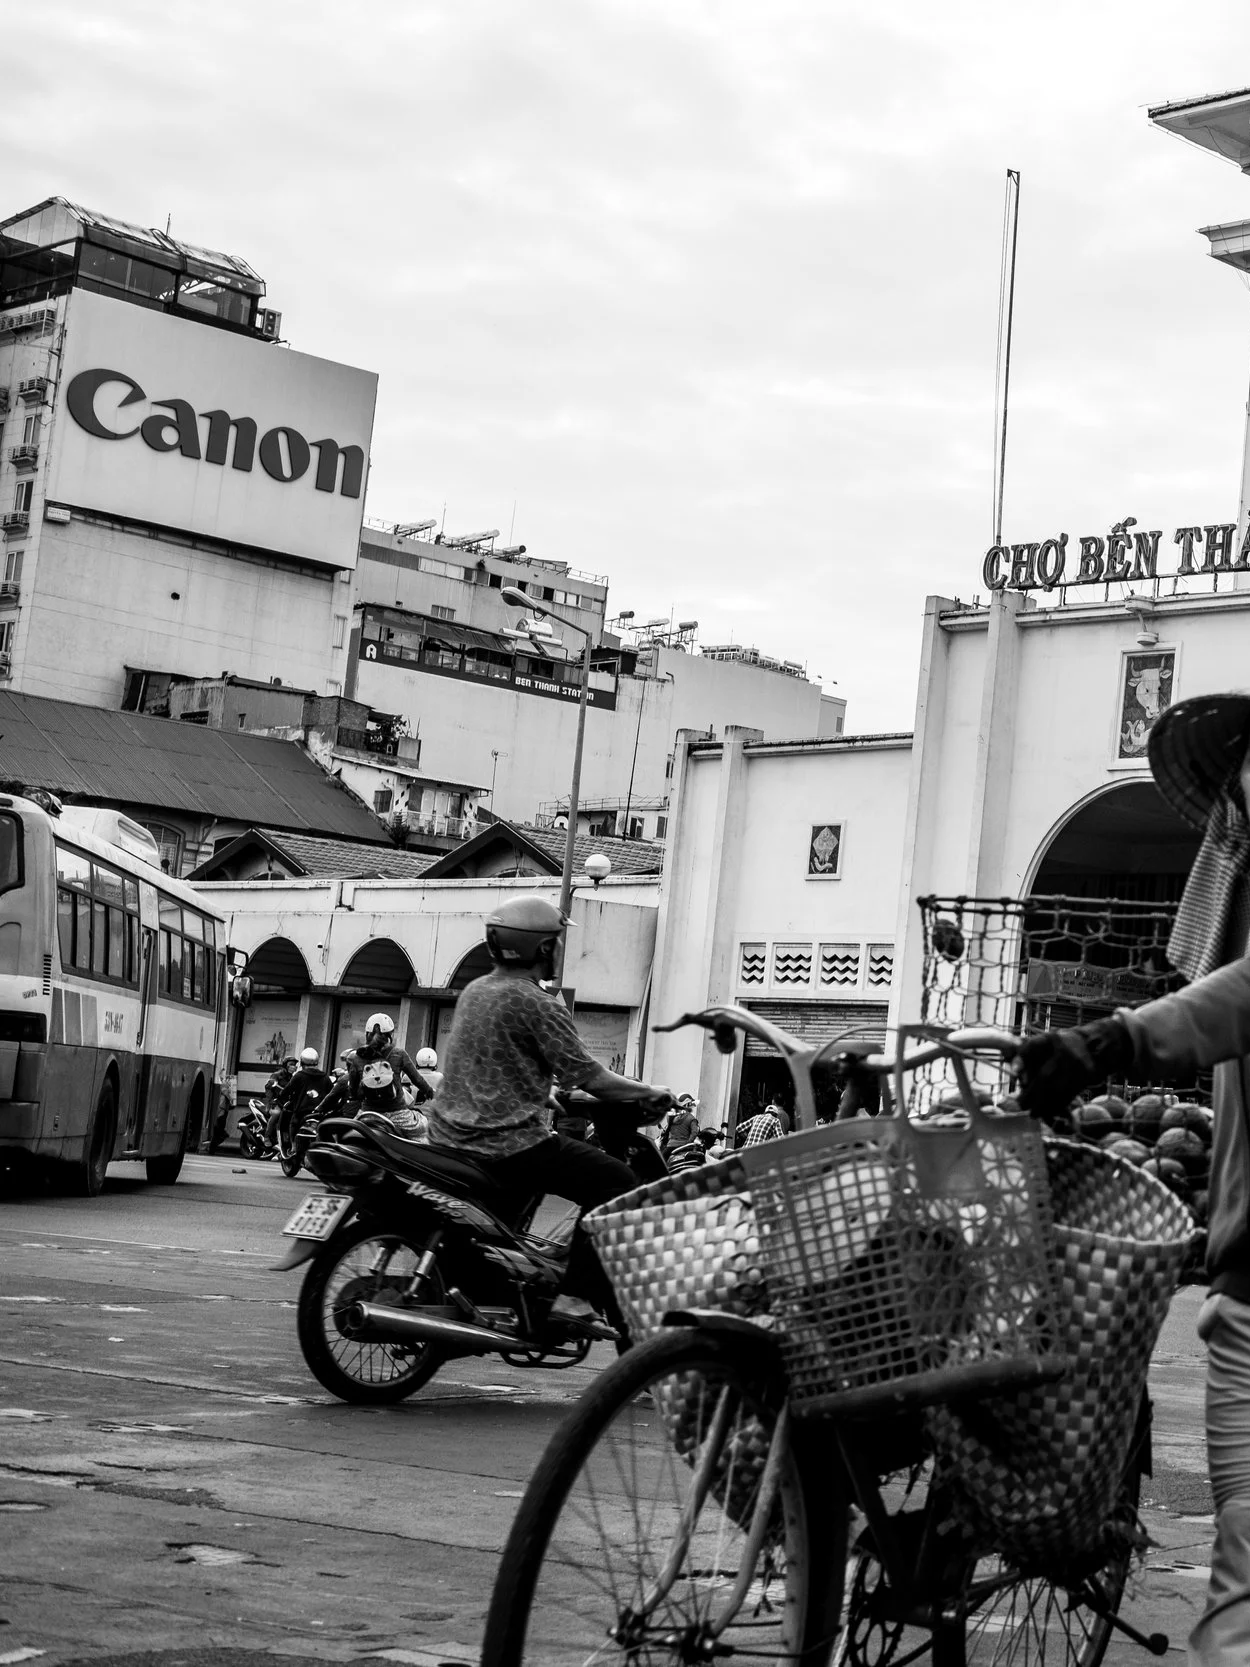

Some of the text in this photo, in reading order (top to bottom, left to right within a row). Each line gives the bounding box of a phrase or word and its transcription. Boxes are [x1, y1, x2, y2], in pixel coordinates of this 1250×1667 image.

[66, 368, 365, 499] Canon
[982, 532, 1069, 592] CHỢ
[1076, 516, 1163, 581] BẾN
[515, 676, 532, 687] BEN
[561, 686, 594, 701] STATN
